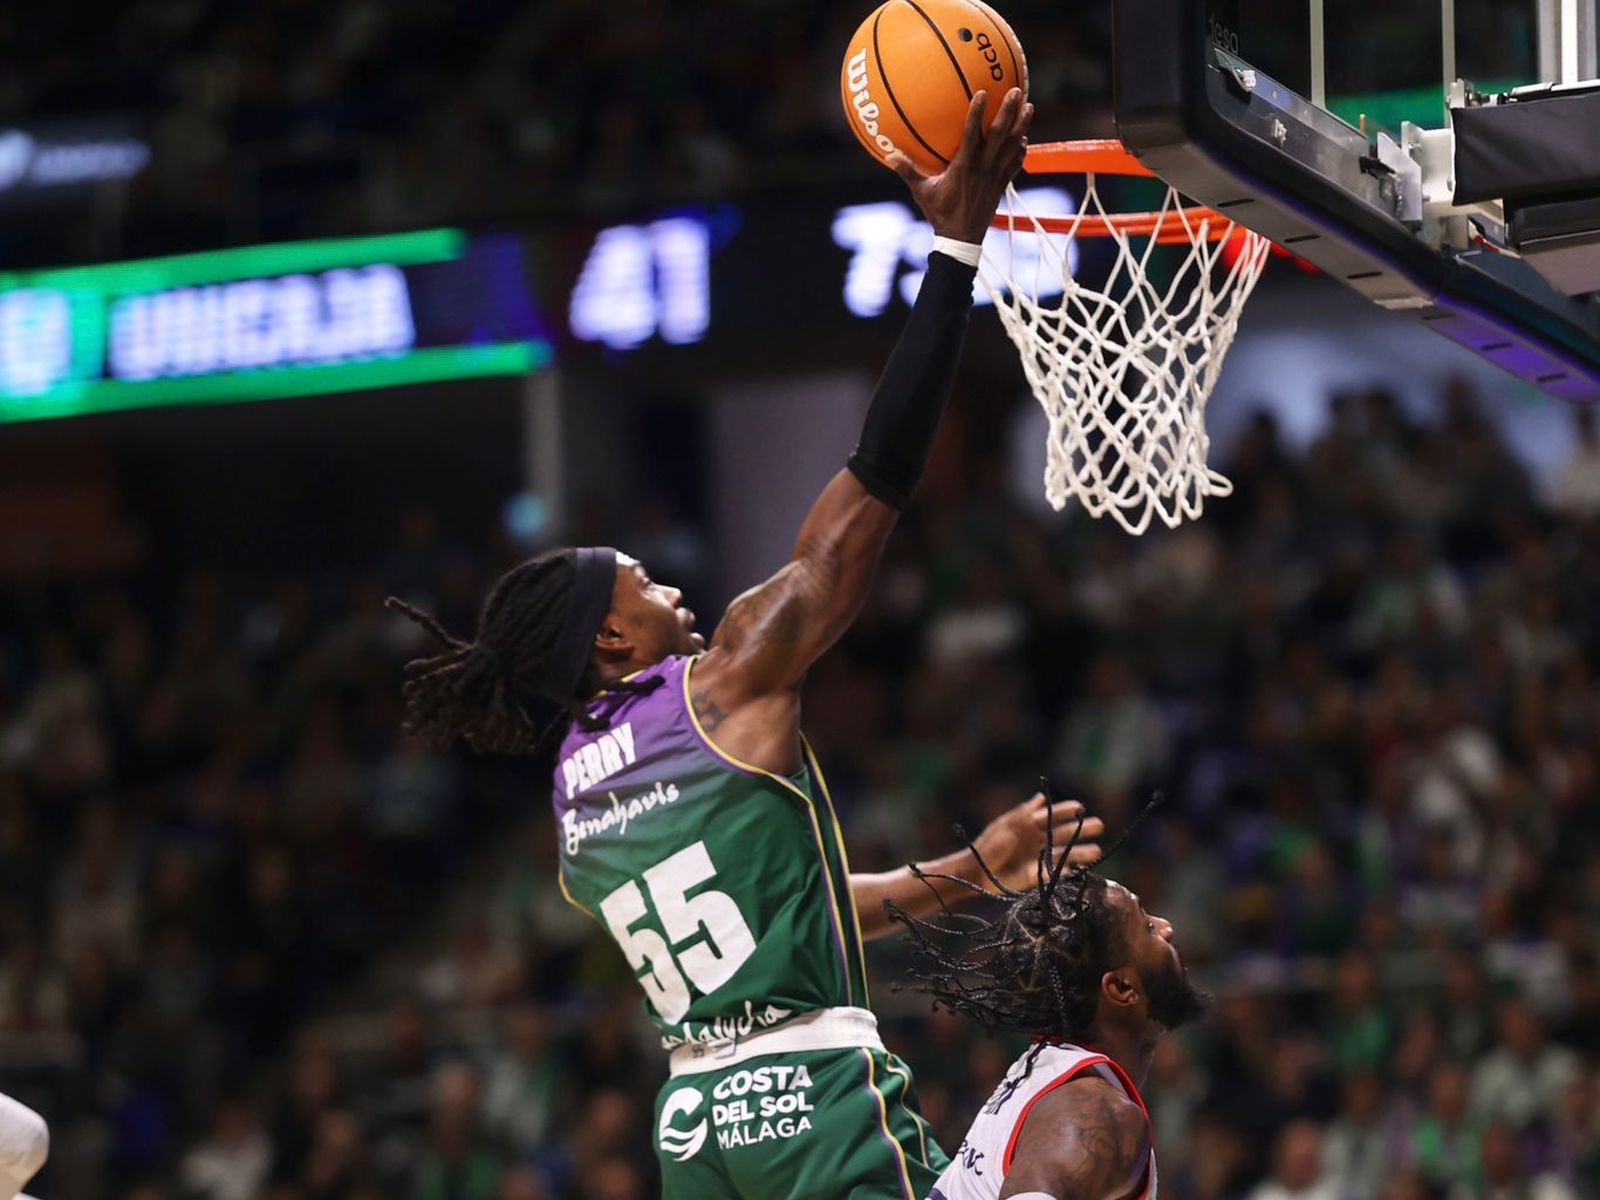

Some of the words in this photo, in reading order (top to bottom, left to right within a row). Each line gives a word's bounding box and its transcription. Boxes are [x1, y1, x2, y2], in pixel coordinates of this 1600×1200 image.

[976, 33, 1003, 81] acb
[562, 721, 636, 800] PERRY
[600, 840, 757, 1026] 55
[713, 1065, 813, 1099] COSTA
[712, 1100, 755, 1126] DEL
[760, 1091, 814, 1117] SOL
[717, 1116, 812, 1150] MÁLAGA
